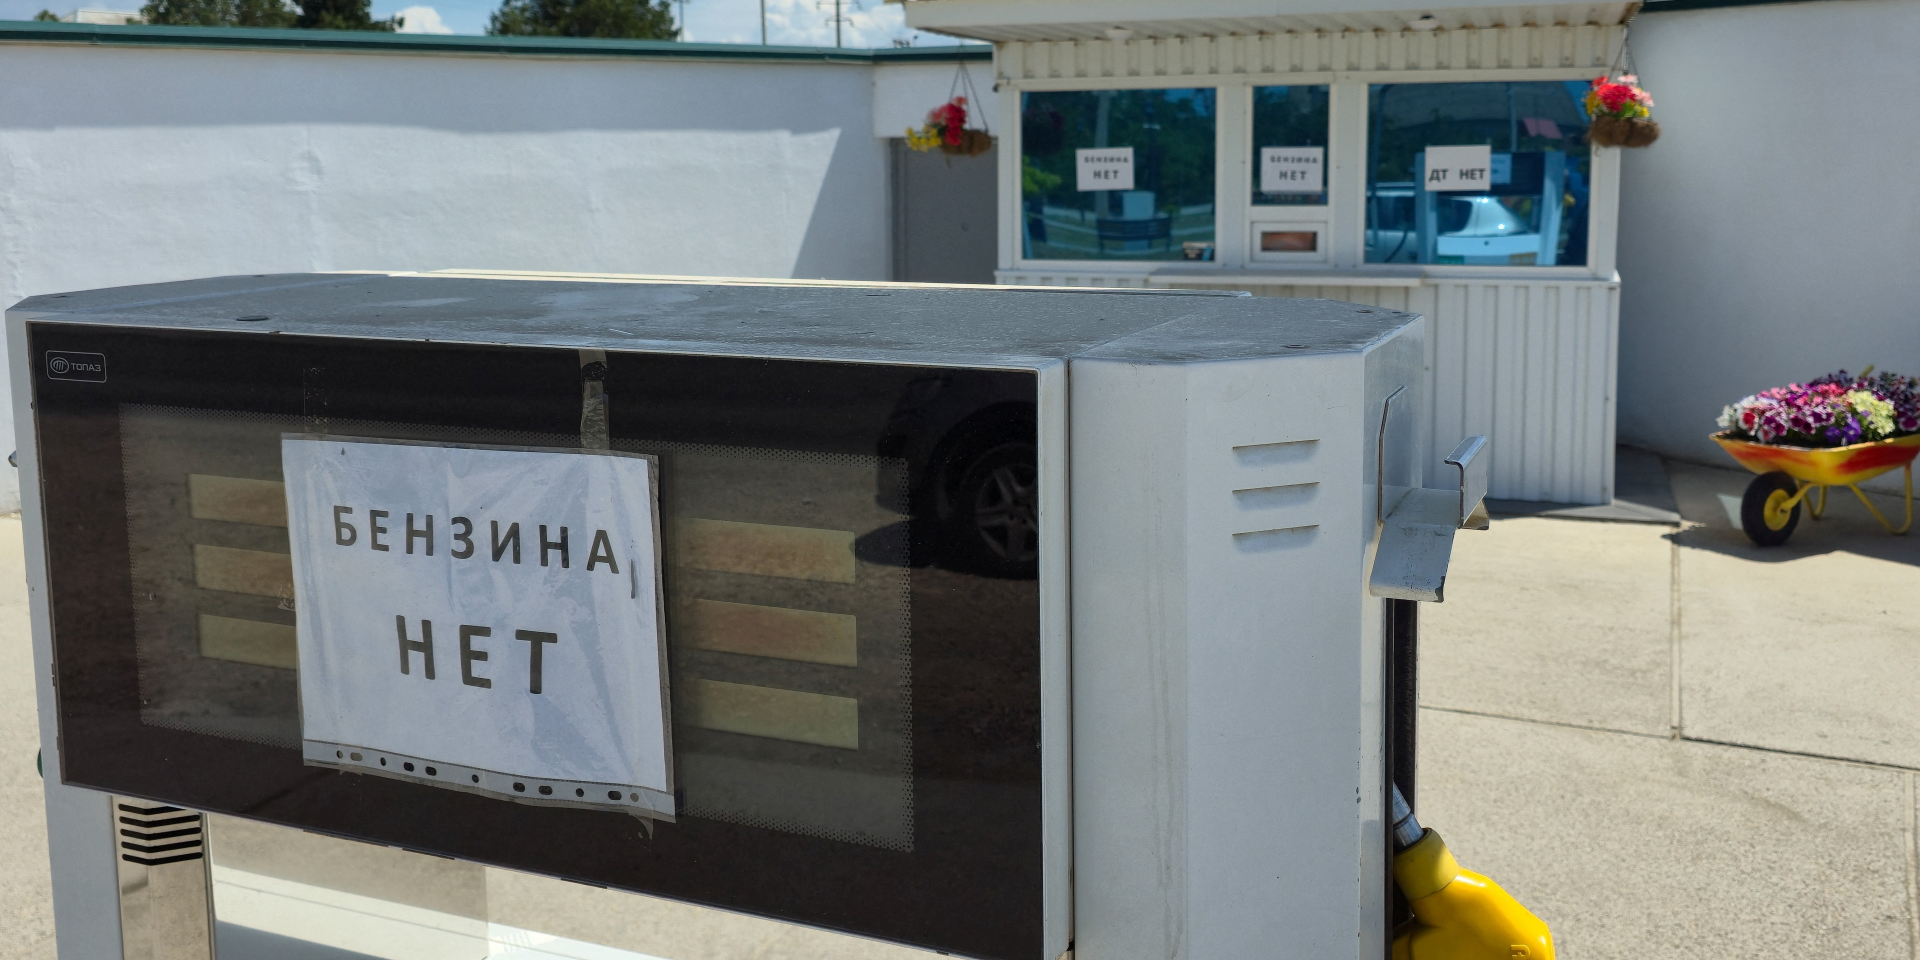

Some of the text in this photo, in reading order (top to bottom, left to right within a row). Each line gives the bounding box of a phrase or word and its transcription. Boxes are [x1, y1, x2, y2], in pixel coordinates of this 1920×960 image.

[1093, 169, 1119, 180] НЕТ
[1279, 170, 1307, 181] НЕТ
[1428, 168, 1486, 183] ДТ НЕТ
[70, 362, 102, 372] ТОПАЗ
[334, 506, 620, 575] БЕНЗИНА
[396, 615, 558, 695] НЕТ
